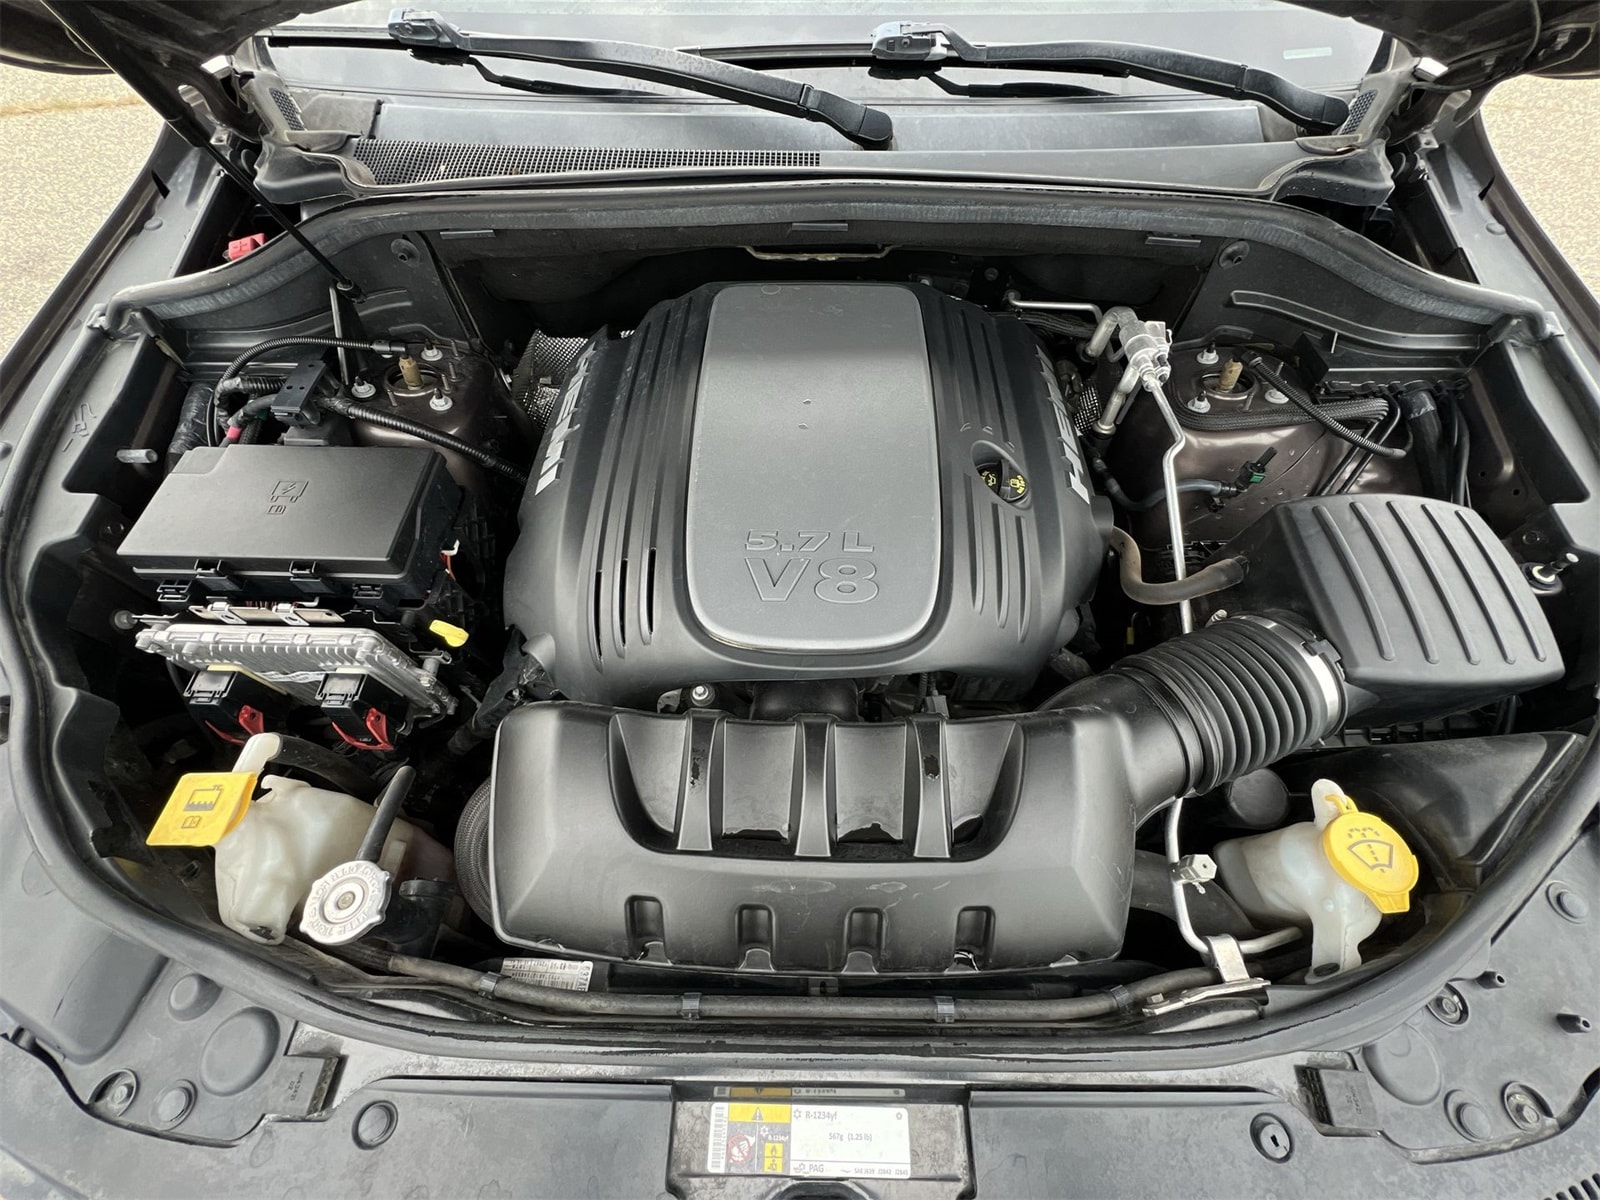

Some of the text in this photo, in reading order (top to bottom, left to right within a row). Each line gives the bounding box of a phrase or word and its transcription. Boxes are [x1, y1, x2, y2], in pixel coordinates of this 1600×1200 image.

[1035, 344, 1091, 505] HEMI
[744, 557, 880, 605] V8
[805, 1111, 838, 1122] R-1234yf
[808, 1163, 825, 1173] PAG
